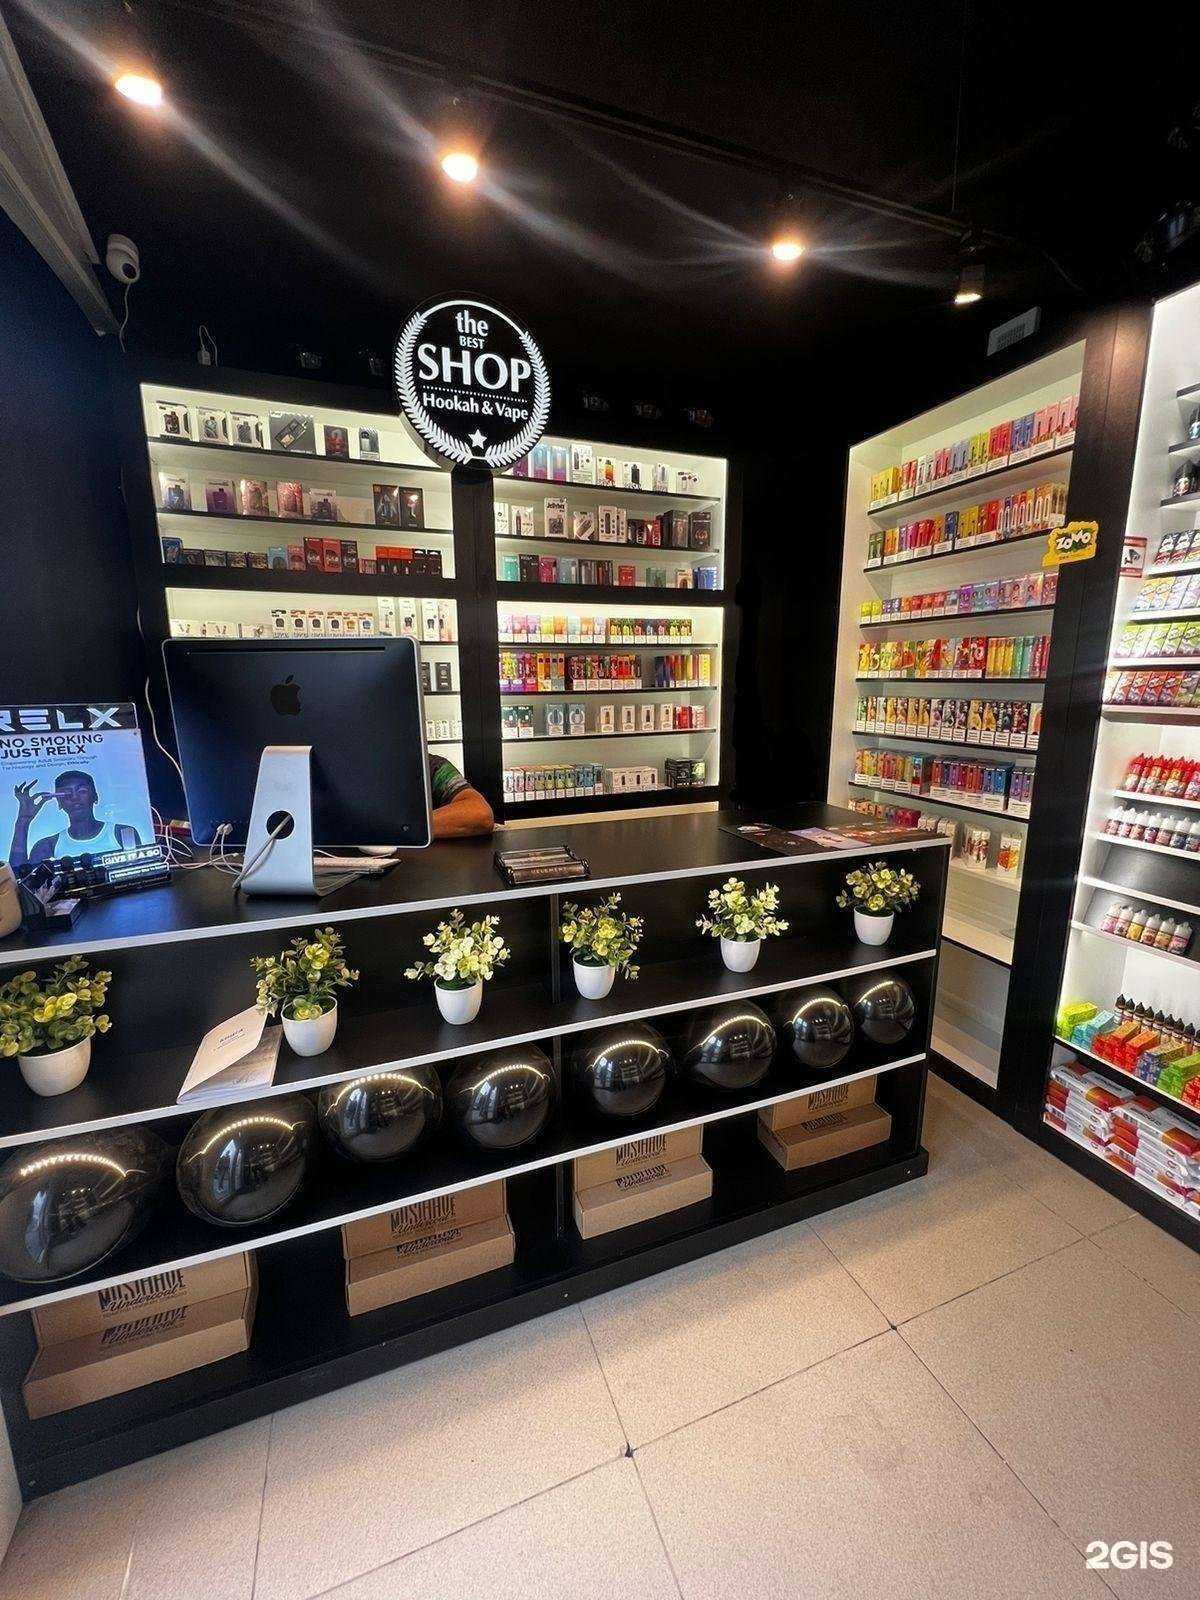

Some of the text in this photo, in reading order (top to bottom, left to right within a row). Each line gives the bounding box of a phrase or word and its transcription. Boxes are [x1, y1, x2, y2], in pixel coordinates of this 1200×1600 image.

[455, 310, 488, 337] the
[459, 336, 485, 349] BEST
[417, 343, 532, 393] SHOP
[422, 392, 529, 422] Hookah & Vape
[0, 734, 104, 750] NO SMOKING
[0, 745, 87, 759] JUST RELX
